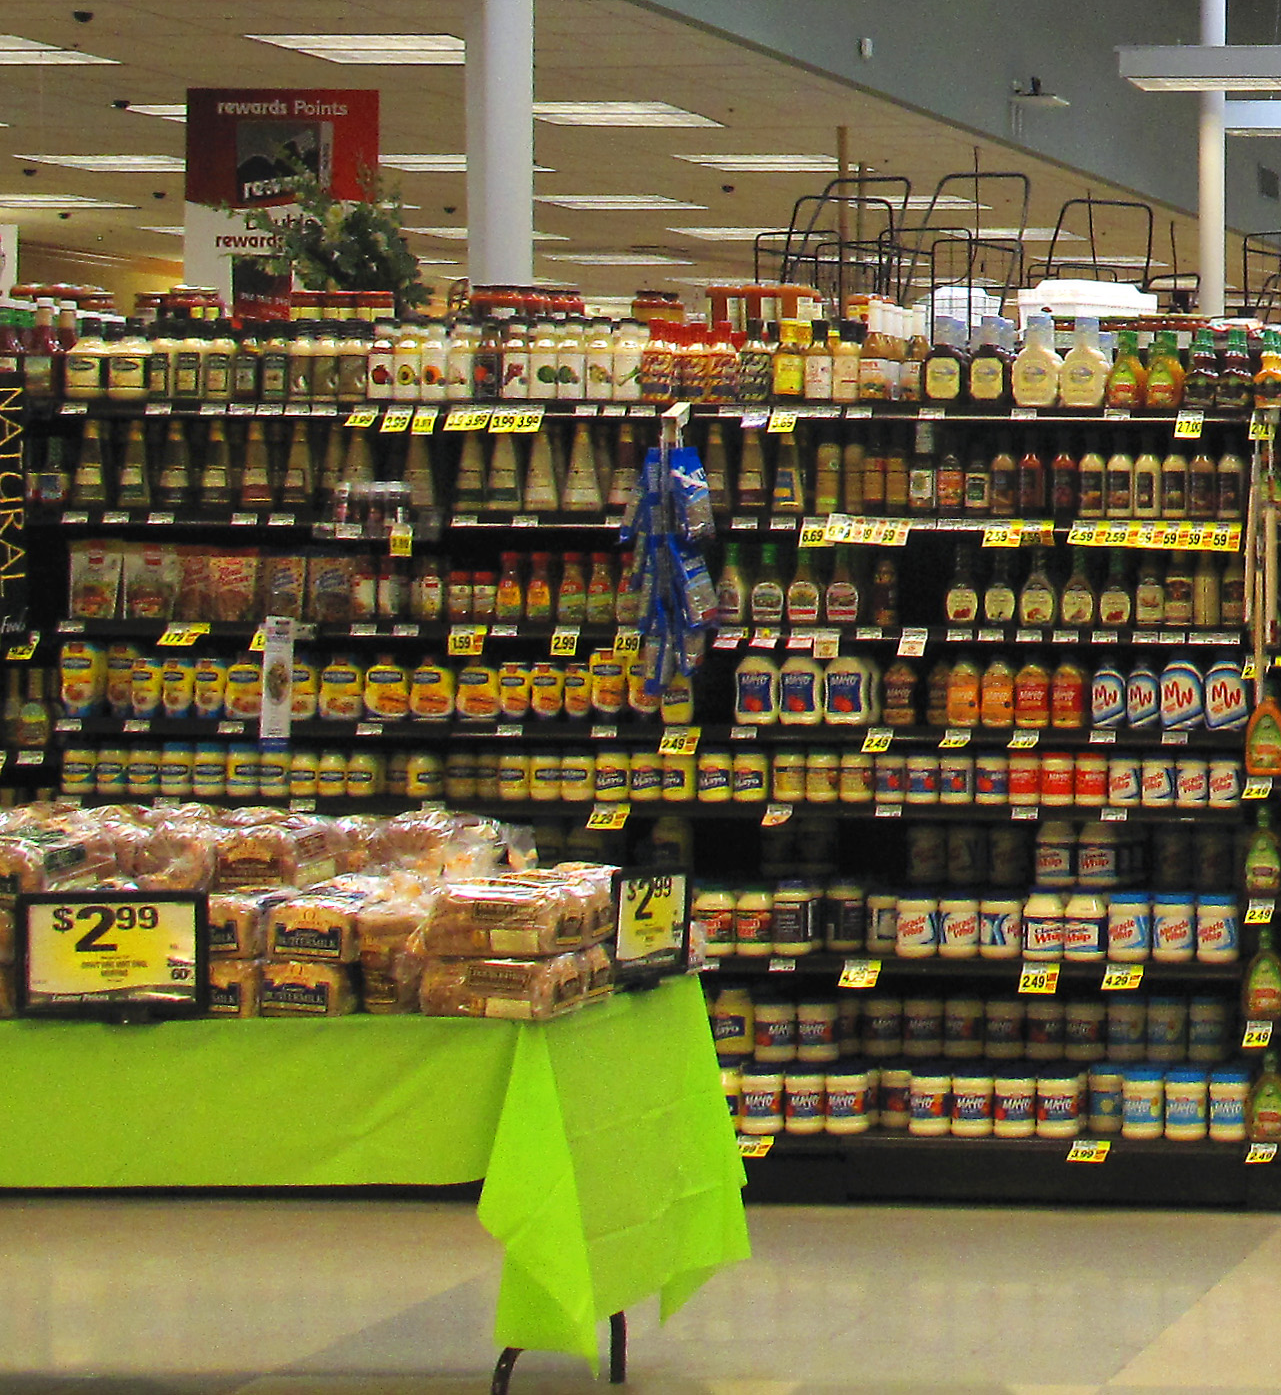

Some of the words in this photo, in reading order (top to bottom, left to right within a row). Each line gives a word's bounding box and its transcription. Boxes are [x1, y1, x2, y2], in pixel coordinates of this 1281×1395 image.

[217, 100, 287, 115] rewards
[294, 100, 348, 116] Points
[493, 417, 515, 428] 3.99
[517, 417, 539, 428] 3.99
[0, 388, 26, 598] NATURAL
[1071, 531, 1094, 542] 2.59
[553, 636, 575, 650] 2.99
[616, 636, 638, 650] 2.99
[662, 738, 684, 751] 2.49
[866, 737, 889, 750] 2.49
[592, 812, 614, 824] 2.29
[1249, 910, 1271, 921] 2.49
[1022, 976, 1044, 989] 2.49
[1246, 1031, 1268, 1043] 2.49
